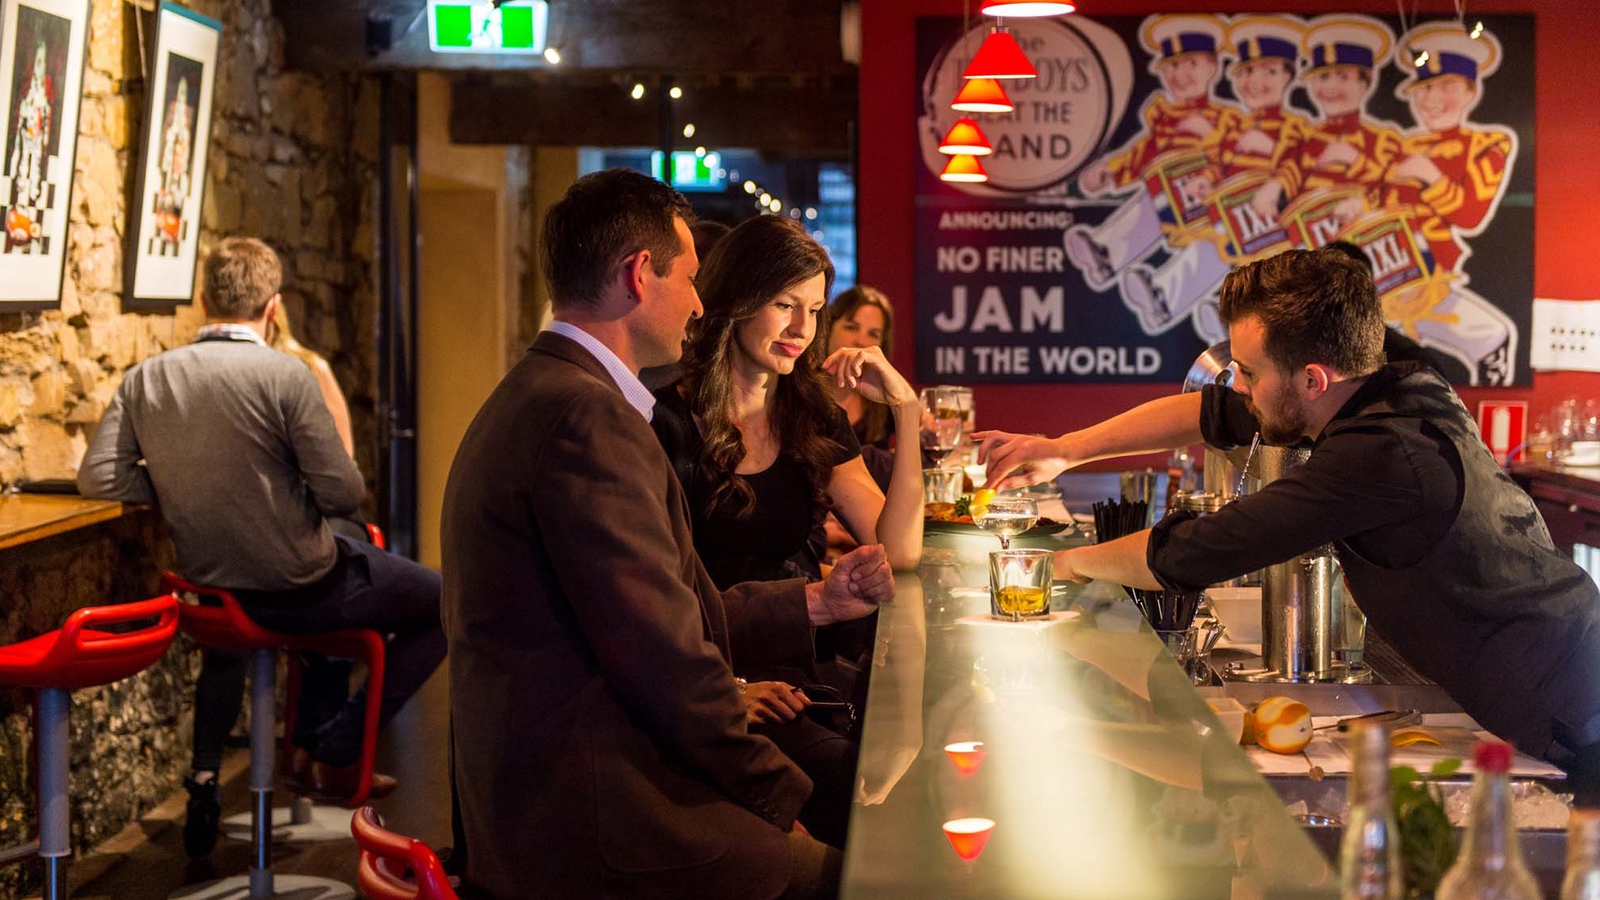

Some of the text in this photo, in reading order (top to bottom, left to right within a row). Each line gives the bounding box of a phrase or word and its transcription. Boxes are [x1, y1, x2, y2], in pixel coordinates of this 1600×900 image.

[1032, 101, 1072, 123] THE
[991, 133, 1072, 161] AND
[937, 246, 1064, 272] NO FINER
[1361, 232, 1411, 281] IXL
[934, 286, 1064, 333] JAM
[935, 346, 1162, 375] IN THE WORLD
